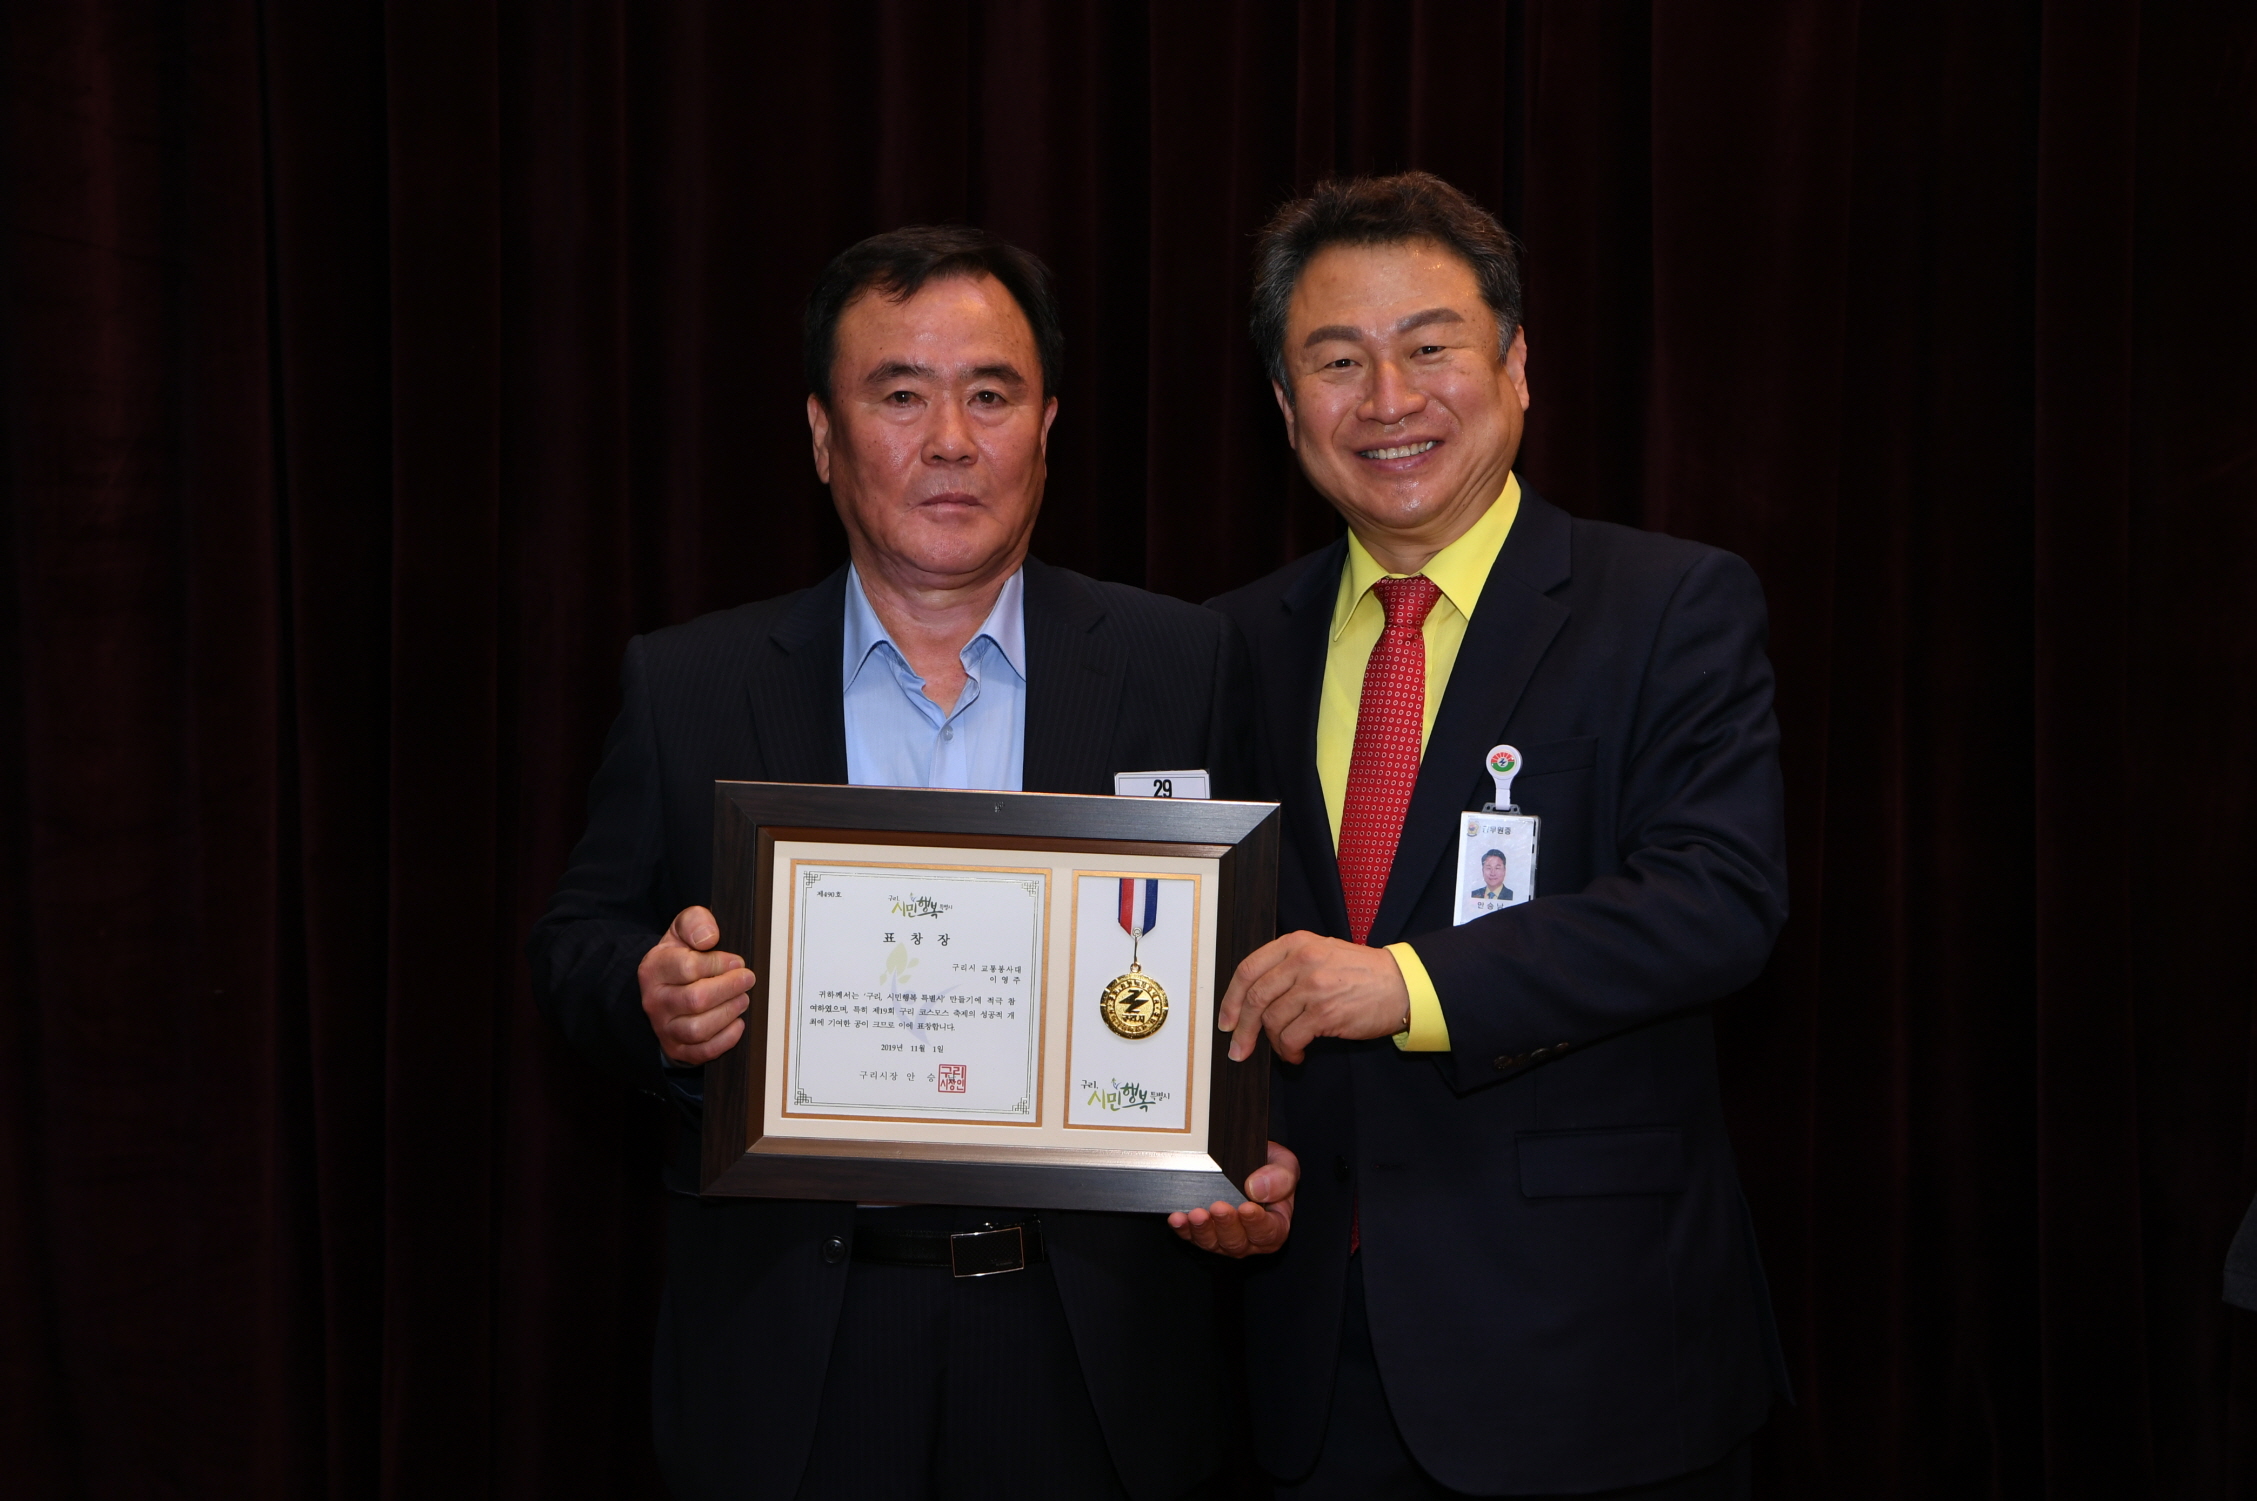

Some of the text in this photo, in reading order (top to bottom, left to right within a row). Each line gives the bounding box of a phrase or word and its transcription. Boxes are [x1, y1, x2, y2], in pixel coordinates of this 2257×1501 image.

[1153, 779, 1173, 798] 29
[952, 963, 976, 972] 구리시
[818, 990, 859, 1000] 귀하께서는
[949, 995, 982, 1004] 만들기에
[872, 1006, 895, 1015] 제19회
[899, 1007, 915, 1016] 구리
[918, 1008, 950, 1017] 코스모스
[953, 1009, 976, 1018] 축제의
[980, 1010, 1003, 1019] 성공적
[828, 1019, 851, 1028] 기여한
[880, 1043, 944, 1054] 2019년 11월 1일
[859, 1070, 899, 1081] 구리시장
